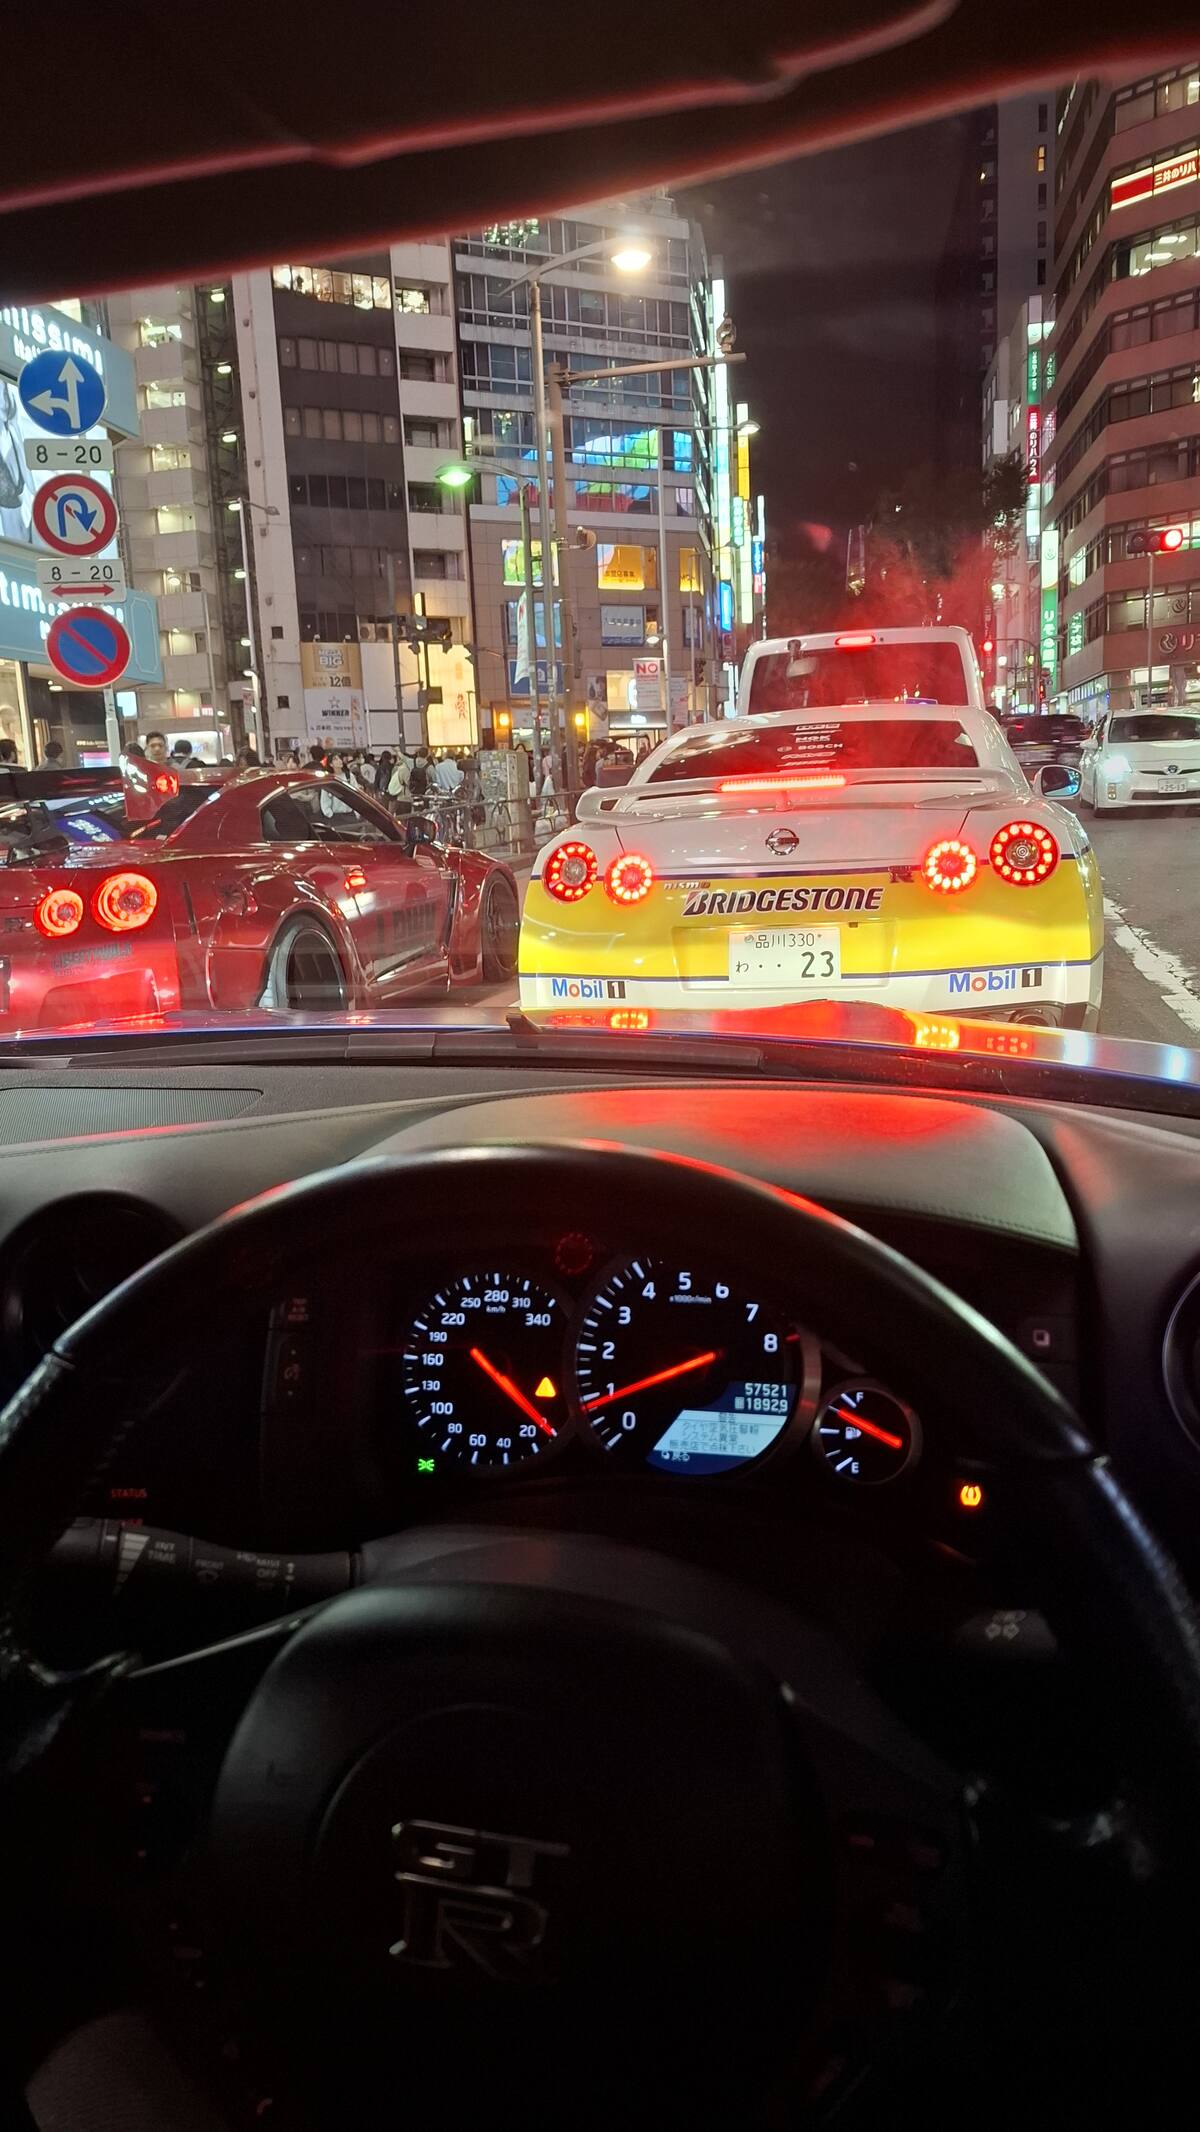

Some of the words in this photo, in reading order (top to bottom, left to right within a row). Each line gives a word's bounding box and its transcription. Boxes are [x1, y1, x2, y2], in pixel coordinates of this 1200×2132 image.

[797, 743, 843, 751] BOSCH
[682, 887, 884, 916] BRIDGESTONE
[801, 950, 835, 978] 23
[949, 969, 1016, 993] Mobil
[552, 978, 604, 999] Mobil
[678, 1272, 691, 1290] 5
[484, 1289, 509, 1303] 280
[642, 1282, 656, 1299] 4
[715, 1282, 729, 1299] 6
[460, 1297, 481, 1308] 250
[512, 1297, 531, 1308] 310
[441, 1313, 466, 1326] 220
[618, 1306, 631, 1325] 3
[745, 1303, 759, 1322] 7
[525, 1313, 551, 1327] 340
[429, 1331, 447, 1343] 190
[763, 1333, 778, 1352] 8
[602, 1342, 615, 1360] 2
[422, 1353, 444, 1366] 160
[422, 1380, 440, 1392] 130
[744, 1382, 787, 1397] 57521
[855, 1392, 864, 1403] F
[430, 1402, 453, 1415] 100
[622, 1411, 636, 1430] 0
[448, 1423, 463, 1434] 80
[519, 1425, 537, 1437] 20
[469, 1434, 486, 1446] 60
[496, 1437, 512, 1448] 40
[851, 1462, 860, 1474] E
